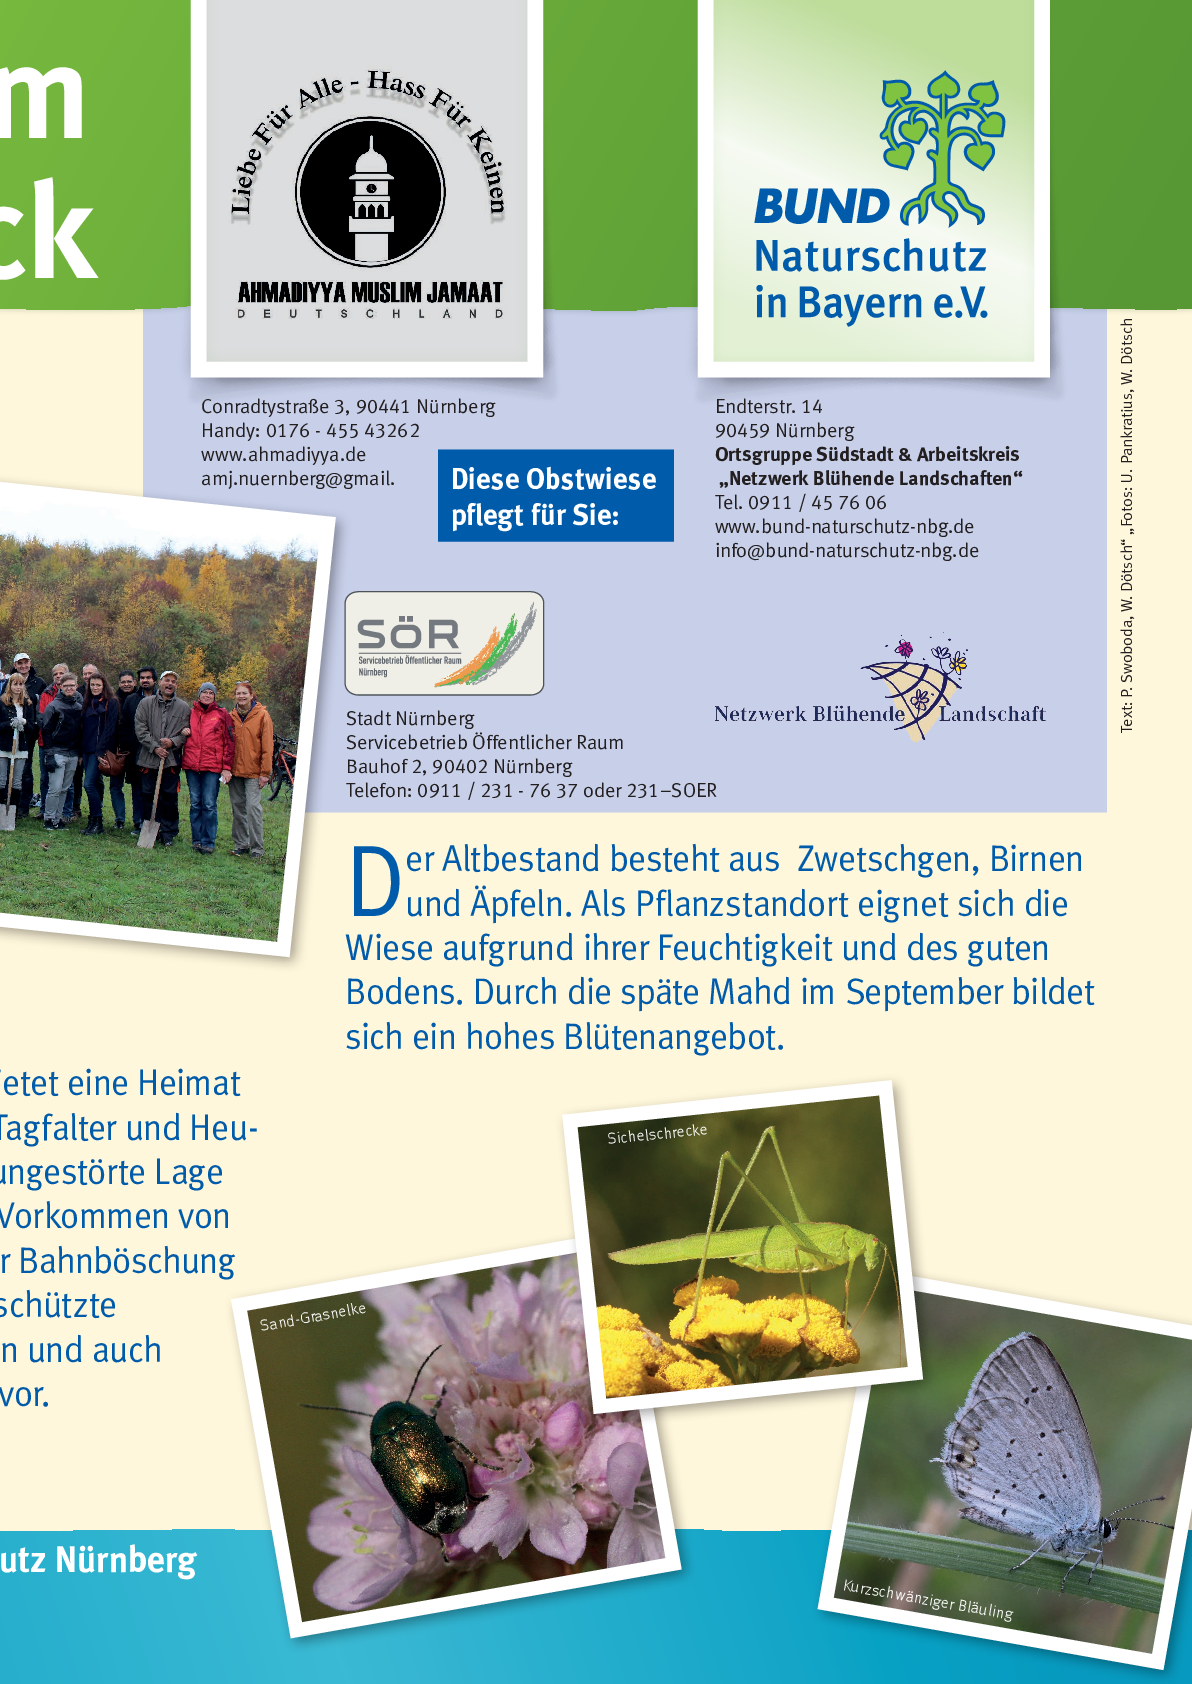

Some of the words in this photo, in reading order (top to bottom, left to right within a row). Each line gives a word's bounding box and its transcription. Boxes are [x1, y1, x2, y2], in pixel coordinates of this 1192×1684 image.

[231, 148, 262, 215] Liebe
[252, 104, 293, 145] Für
[299, 77, 344, 110] Alle
[367, 70, 426, 99] Hass
[429, 88, 472, 129] Für
[467, 126, 506, 214] Keinen
[754, 187, 890, 225] BUND
[756, 238, 986, 272] Naturschutz
[238, 282, 346, 302] AHMADIYYA
[352, 282, 421, 303] MUSLIM
[427, 282, 503, 303] JAMAAT
[238, 308, 503, 319] DEUTSCHLAND
[756, 285, 786, 317] in
[800, 286, 921, 327] Bayern
[934, 286, 988, 318] e.V.
[1119, 319, 1133, 363] Dötsch
[1120, 370, 1133, 385] W.
[202, 398, 328, 417] Conradtystraße
[335, 400, 349, 415] 3,
[357, 400, 409, 415] 90441
[418, 398, 495, 417] Nürnberg
[717, 398, 795, 413] Endterstr.
[803, 400, 822, 413] 14
[203, 422, 259, 441] Handy:
[267, 423, 309, 437] 0176
[327, 424, 358, 438] 455
[365, 423, 419, 438] 43262
[716, 424, 769, 438] 90459
[777, 422, 854, 441] Nürnberg
[1119, 390, 1134, 462] Pankratius,
[201, 446, 366, 465] www.ahmadiyya.de
[716, 447, 812, 465] Ortsgruppe
[816, 446, 893, 461] Südstadt
[899, 448, 912, 461] &
[917, 446, 1019, 461] Arbeitskreis
[202, 470, 394, 489] amj.nuernberg@gmail.
[453, 467, 519, 490] Diese
[527, 467, 656, 490] Obstwiese
[814, 470, 894, 485] Blühende
[1120, 470, 1133, 482] U.
[715, 494, 742, 509] Tel.
[749, 496, 791, 510] 0911
[812, 496, 832, 510] 45
[839, 495, 859, 509] 76
[866, 495, 886, 509] 06
[453, 503, 523, 531] pflegt
[532, 503, 566, 525] für
[573, 503, 618, 525] Sie:
[715, 518, 973, 537] www.bund-naturschutz-nbg.de
[717, 542, 978, 561] info@bund-naturschutz-nbg.de
[1120, 597, 1133, 612] W.
[1119, 617, 1134, 682] Swoboda,
[358, 656, 403, 665] Servicebetrieb
[405, 655, 442, 665] Öffentlicher
[444, 656, 462, 665] Raum
[358, 668, 388, 678] Nürnberg
[1120, 688, 1133, 697] P.
[347, 710, 391, 726] Stadt
[397, 710, 475, 730] Nürnberg
[714, 706, 807, 722] Netzwerk
[813, 705, 906, 722] Blühende
[939, 705, 1047, 722] Landschaft
[1120, 703, 1133, 733] Text:
[347, 734, 467, 749] Servicebetrieb
[473, 732, 572, 749] Öffentlicher
[578, 735, 623, 750] Raum
[348, 758, 408, 774] Bauhof
[413, 760, 426, 775] 2,
[433, 760, 487, 774] 90402
[495, 758, 572, 777] Nürnberg
[346, 782, 411, 797] Telefon:
[418, 784, 460, 798] 0911
[482, 784, 512, 798] 231
[530, 783, 550, 797] 76
[557, 784, 577, 798] 37
[584, 782, 622, 797] oder
[346, 934, 432, 960] Wiese
[444, 933, 572, 967] aufgrund
[585, 933, 650, 960] ihrer
[660, 933, 832, 967] Feuchtigkeit
[844, 933, 895, 961] und
[908, 933, 957, 960] des
[968, 937, 1047, 967] guten
[347, 1022, 401, 1049] sich
[414, 1023, 454, 1049] ein
[468, 1022, 554, 1049] hohes
[566, 1022, 783, 1056] Blütenangebot.
[607, 1123, 708, 1145] Sichelschrecke
[21, 1246, 235, 1280] Bahnböschung
[259, 1302, 367, 1332] Sand-Grasnelke
[30, 1335, 81, 1363] und
[94, 1335, 160, 1363] auch
[57, 1544, 197, 1580] Nürnberg
[843, 1579, 955, 1611] Kurzschwänziger
[958, 1599, 1014, 1623] Bläuling
